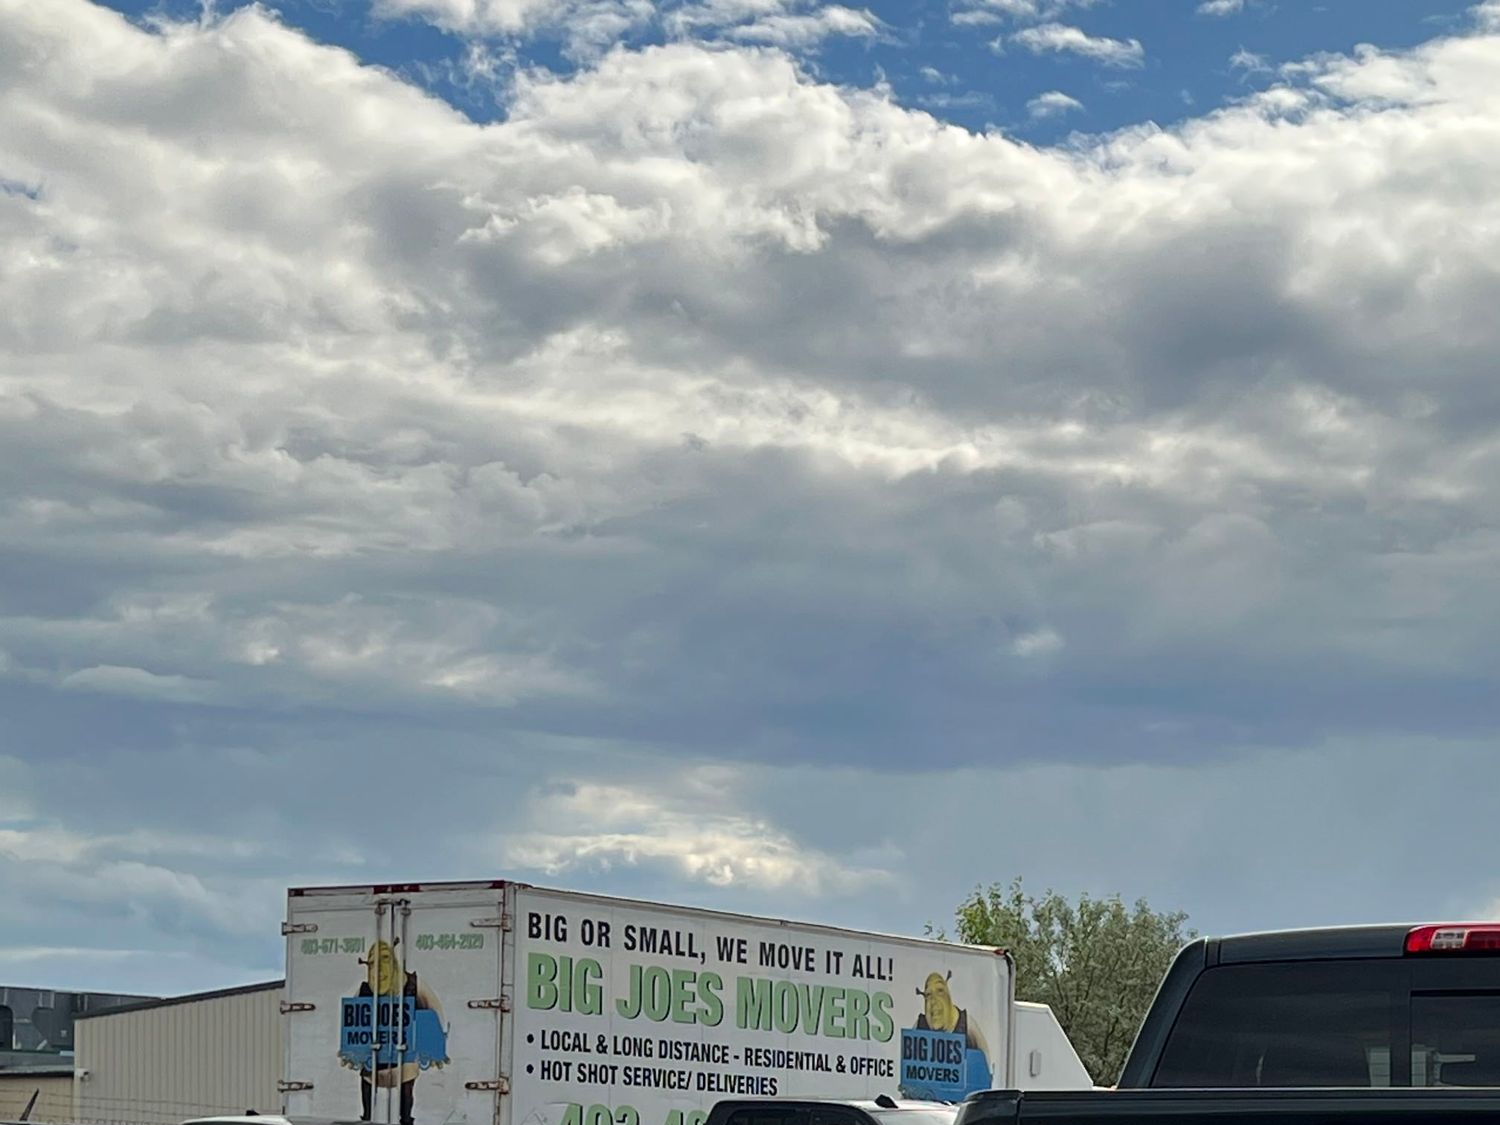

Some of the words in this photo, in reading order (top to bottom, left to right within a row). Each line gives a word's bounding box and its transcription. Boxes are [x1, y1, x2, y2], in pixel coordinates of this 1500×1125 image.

[528, 912, 567, 942] BIG
[581, 918, 611, 948] OR
[624, 925, 706, 964] SMALL,
[716, 936, 747, 964] WE
[759, 942, 815, 972] MOVE
[826, 950, 844, 975] IT
[852, 954, 894, 981] ALL!
[344, 1003, 371, 1027] BIG
[527, 952, 603, 1016] BIG
[615, 964, 724, 1027] JOES
[736, 976, 895, 1043] MOVERS
[541, 1029, 592, 1053] LOCAL
[596, 1034, 608, 1054] &
[613, 1035, 653, 1058] LONG
[658, 1039, 729, 1064] DISTANCE
[744, 1047, 832, 1072] RESIDENTIAL
[835, 1055, 846, 1073] &
[850, 1056, 894, 1077] OFFICE
[903, 1036, 928, 1061] BIG
[930, 1038, 962, 1065] JOES
[541, 1060, 572, 1082] HOT
[576, 1062, 618, 1085] SHOT
[696, 1072, 778, 1096] DELIVERIES
[906, 1065, 960, 1083] MOVERS
